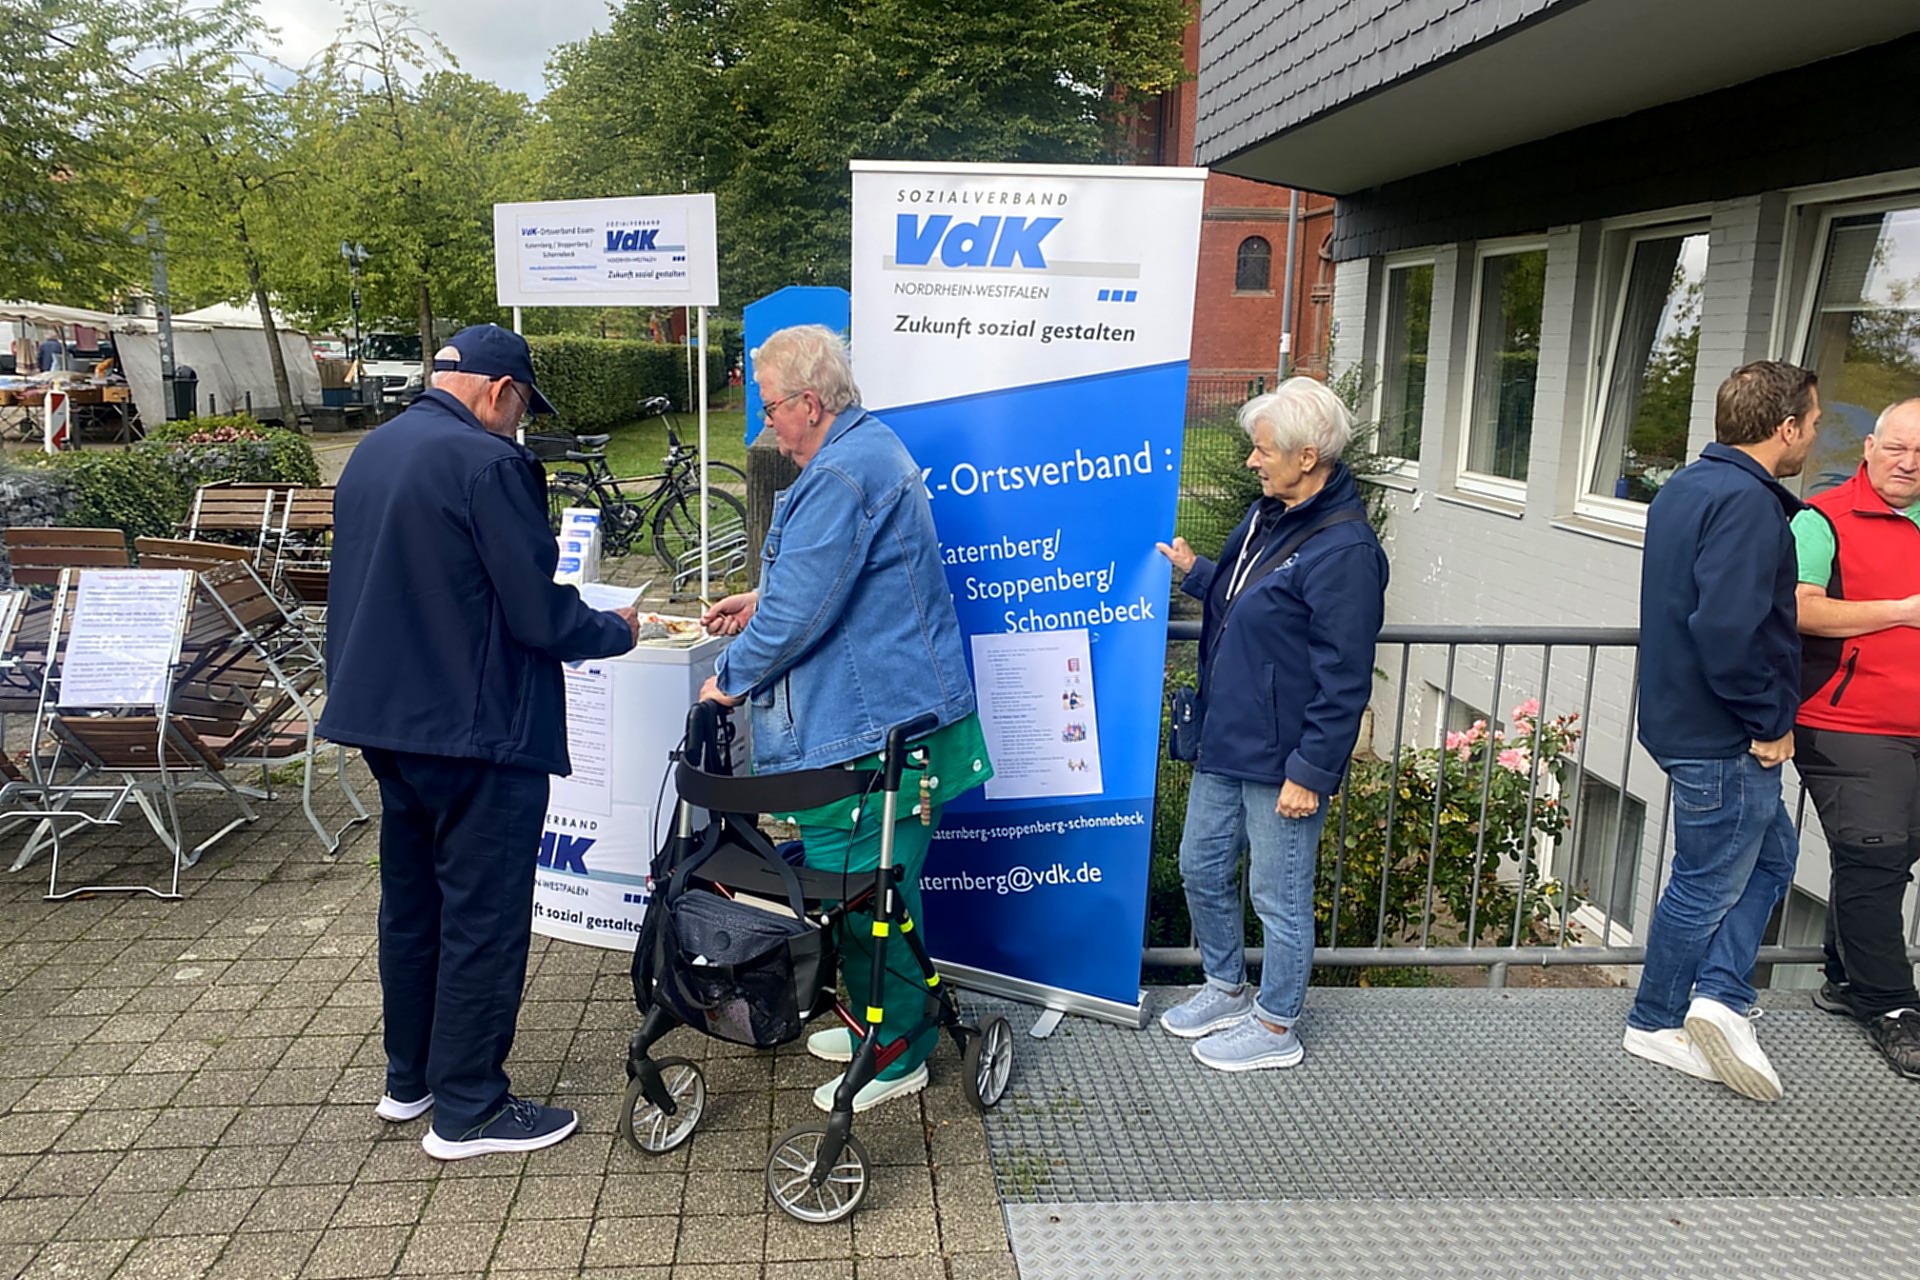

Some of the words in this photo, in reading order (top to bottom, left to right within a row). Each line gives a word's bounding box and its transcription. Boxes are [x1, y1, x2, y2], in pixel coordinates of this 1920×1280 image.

[896, 189, 1069, 206] SOZIALVERBAND
[606, 228, 660, 251] VdK
[895, 213, 1063, 269] VdK
[608, 270, 634, 280] Zukunft
[635, 270, 654, 279] sozial
[655, 270, 686, 280] gestalten
[894, 282, 1050, 300] NORDRHEIN-WESTFALEN
[893, 314, 972, 339] Zukunft
[978, 319, 1036, 338] sozial
[1041, 322, 1136, 344] gestalten
[966, 561, 1117, 604] Stoppenberg/
[1004, 596, 1155, 634] Schonnebeck
[933, 811, 1145, 842] aternberg-stoppenberg-schonnebeck
[547, 908, 583, 924] sozial
